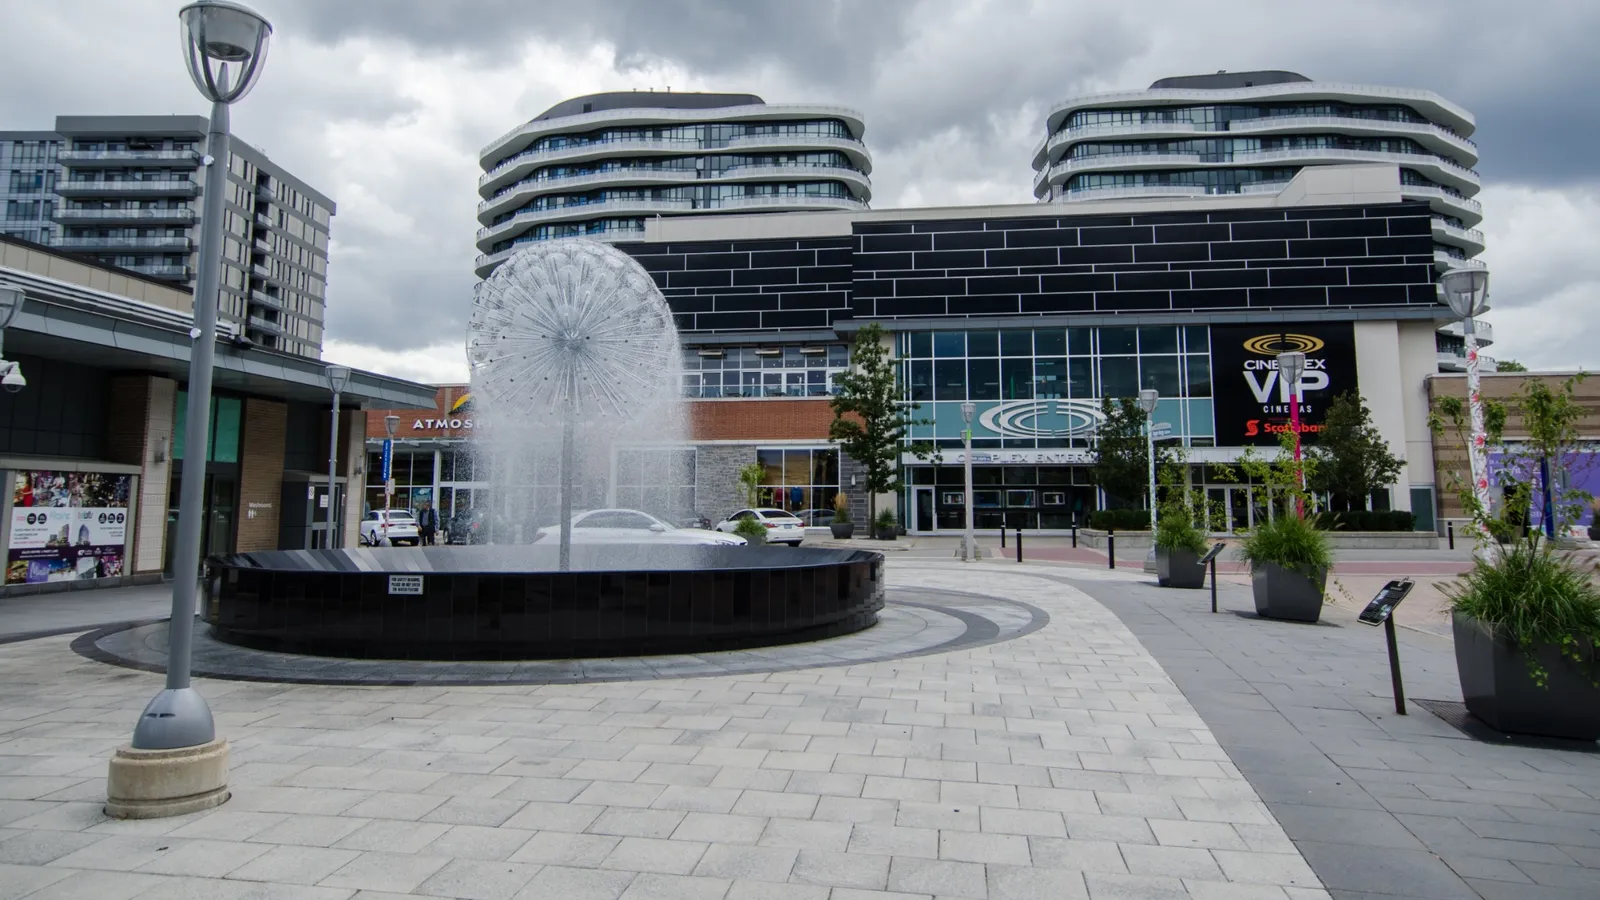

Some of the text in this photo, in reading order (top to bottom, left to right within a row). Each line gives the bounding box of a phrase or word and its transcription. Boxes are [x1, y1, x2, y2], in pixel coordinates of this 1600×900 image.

[1243, 359, 1326, 370] CINEEX
[1242, 370, 1330, 403] VIP
[1262, 405, 1312, 413] CINEAS
[411, 418, 503, 429] ATMOSP
[956, 453, 1028, 463] CPLEX
